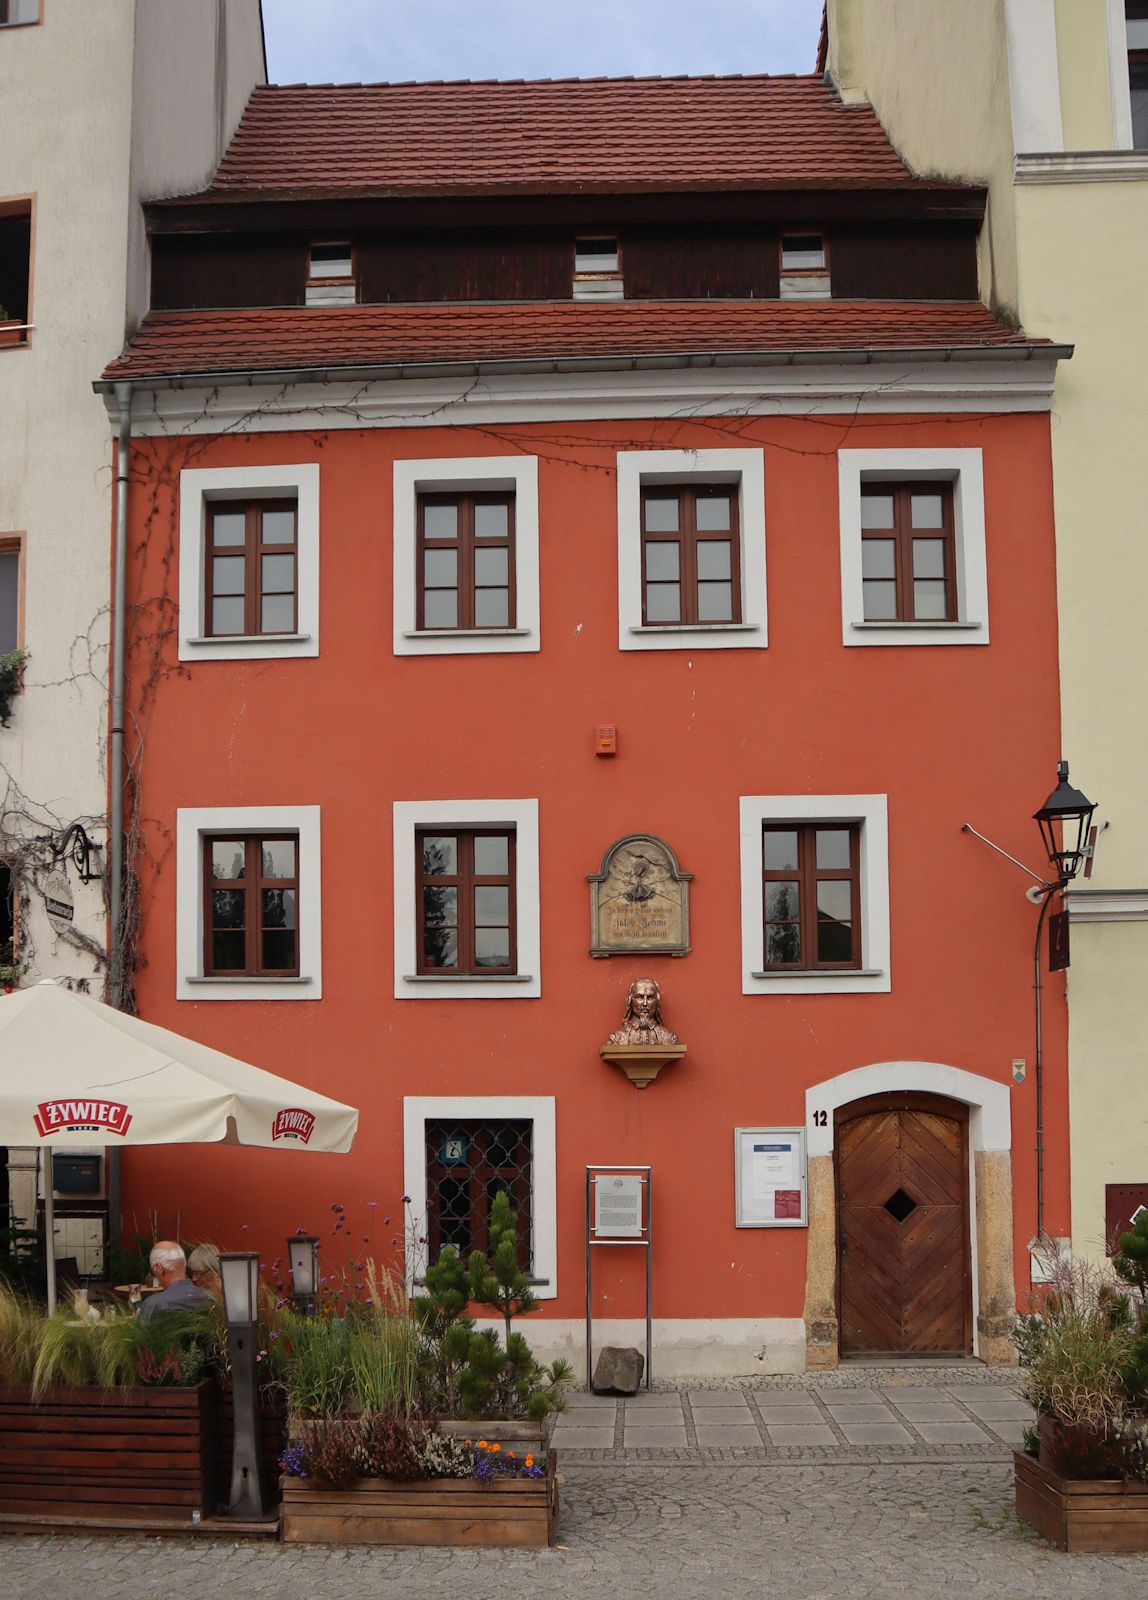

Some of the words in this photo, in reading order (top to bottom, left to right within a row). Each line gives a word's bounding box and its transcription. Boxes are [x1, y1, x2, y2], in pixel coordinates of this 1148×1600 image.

[46, 1102, 121, 1125] ŻYWIEC
[278, 1111, 312, 1133] ŻYWIEC
[813, 1110, 828, 1127] 12
